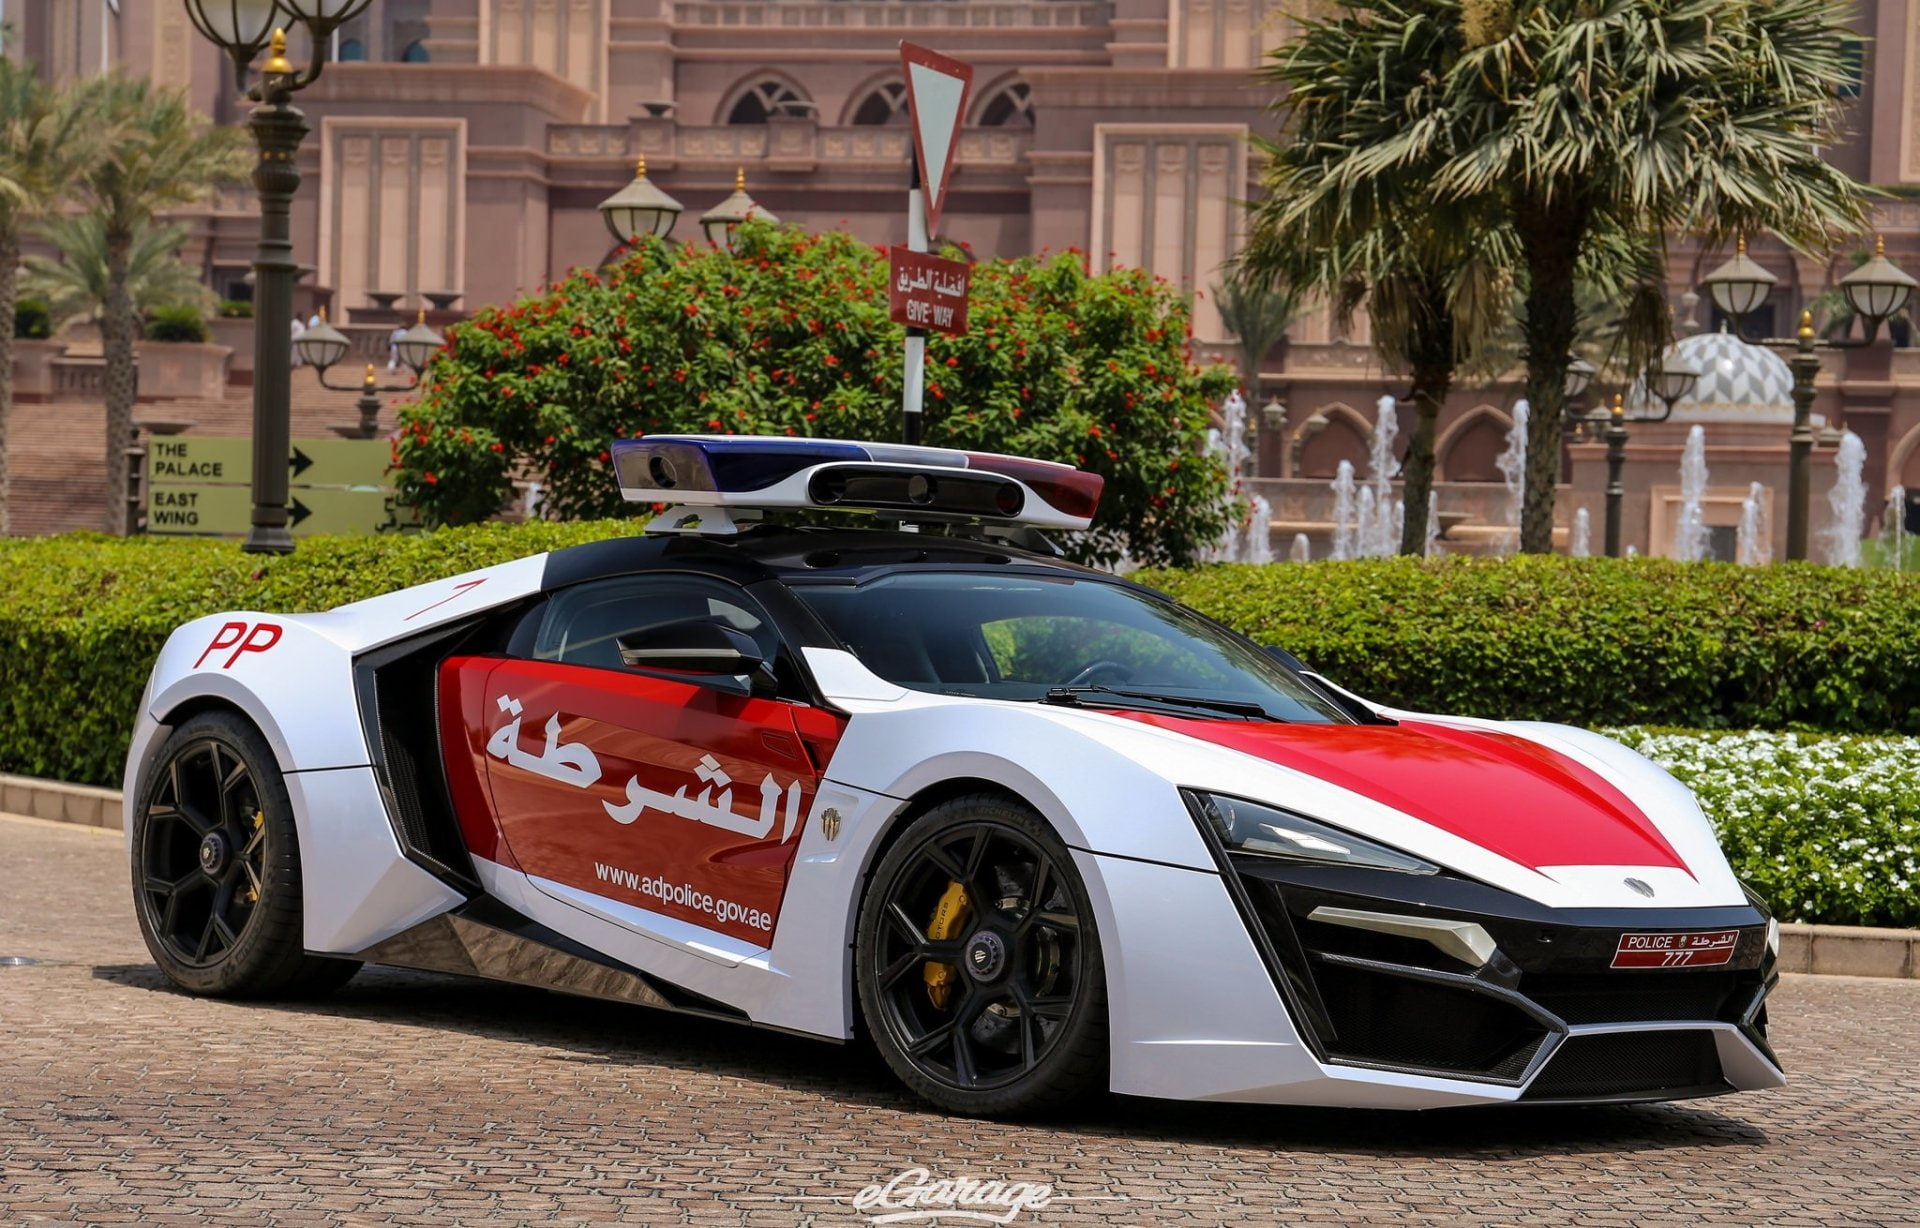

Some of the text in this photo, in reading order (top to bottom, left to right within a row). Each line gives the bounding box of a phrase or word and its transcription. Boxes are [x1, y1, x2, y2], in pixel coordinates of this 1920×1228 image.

[897, 266, 932, 293] الطريق
[906, 299, 954, 328] GIVE WAY
[155, 443, 187, 458] THE
[155, 462, 222, 477] PALACE
[154, 492, 198, 506] EAST
[154, 510, 199, 526] WING
[192, 621, 283, 670] PP
[485, 693, 802, 846] الشرطة
[594, 861, 772, 932] www.adpolice.gov.ae
[935, 902, 949, 939] OTORS
[1627, 936, 1673, 949] POLICE
[1691, 934, 1734, 948] الشرطة
[1661, 951, 1694, 966] 777
